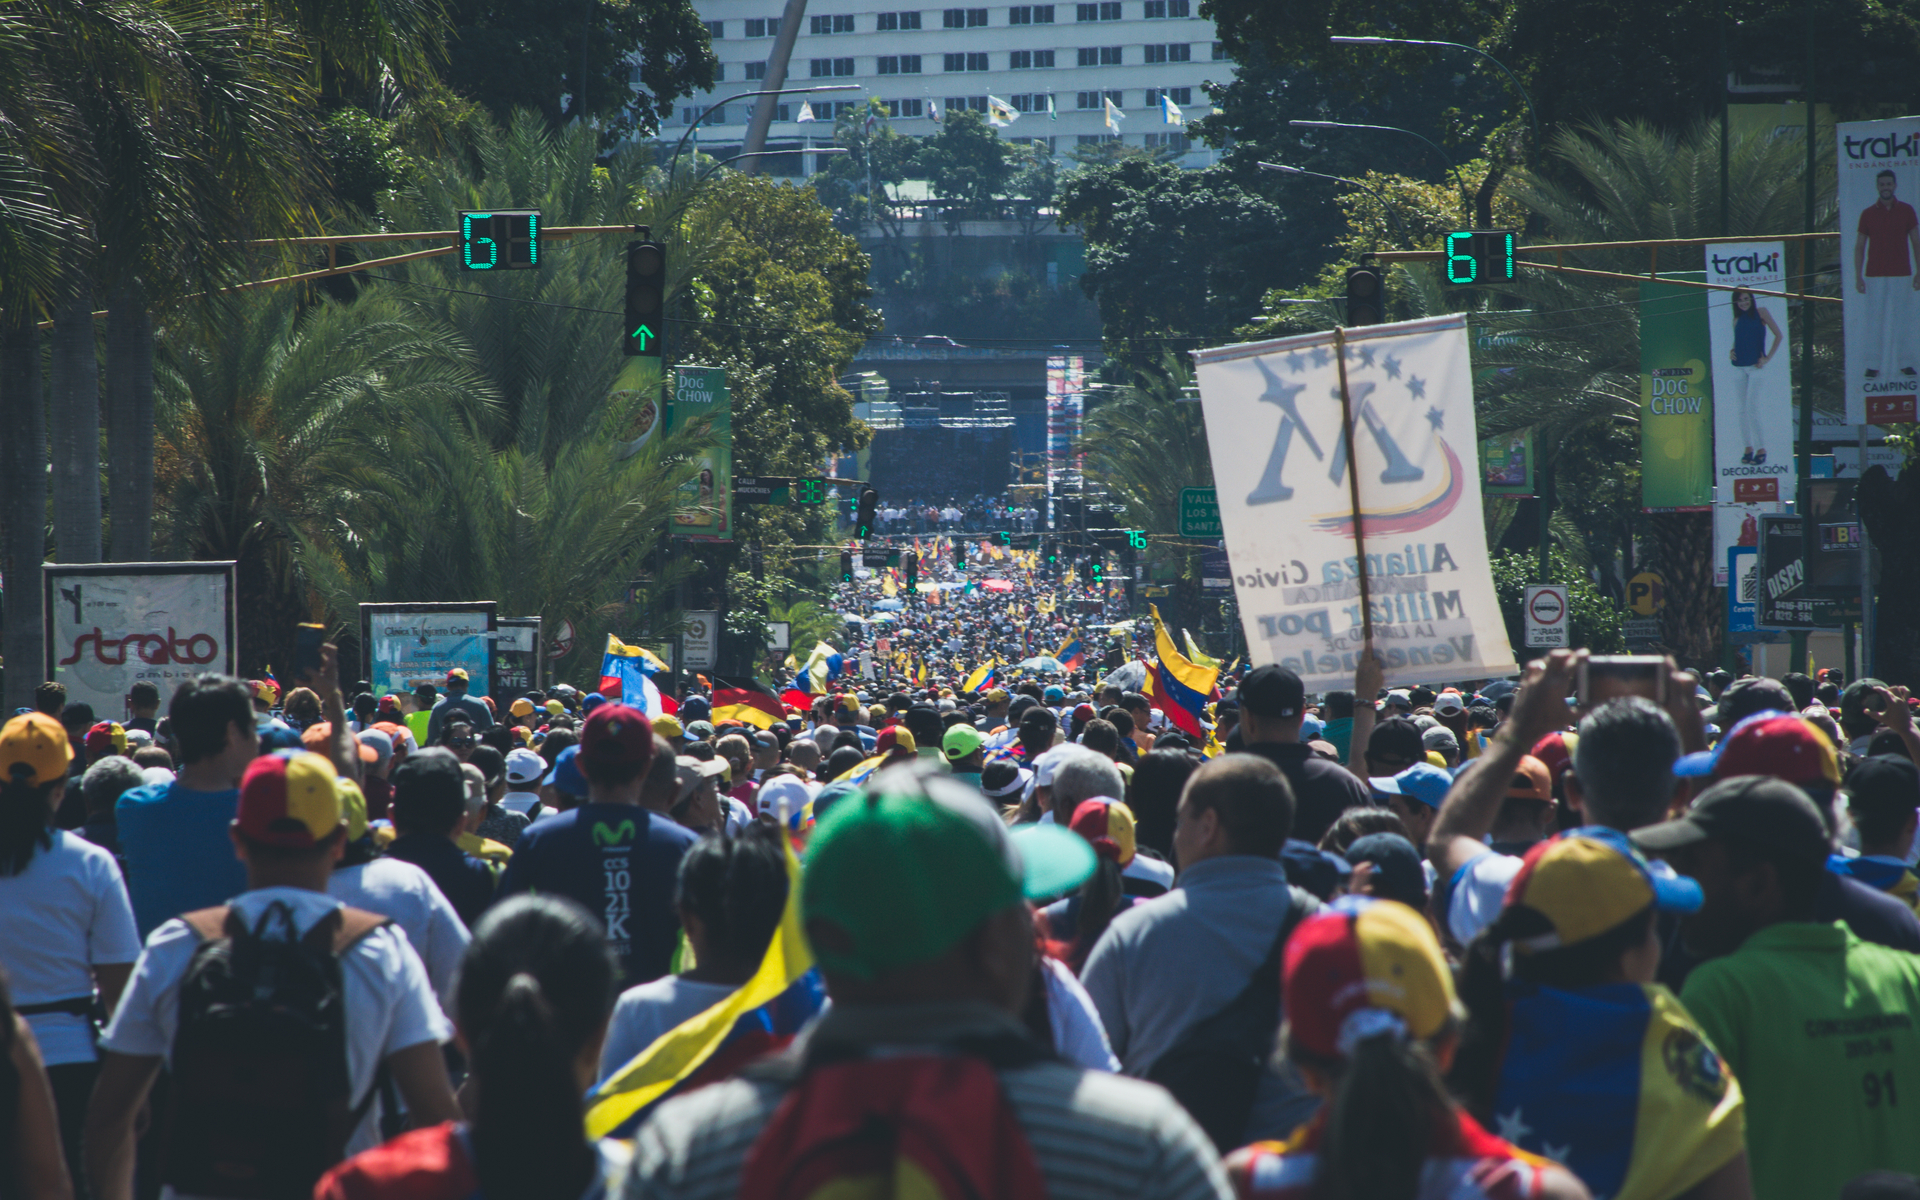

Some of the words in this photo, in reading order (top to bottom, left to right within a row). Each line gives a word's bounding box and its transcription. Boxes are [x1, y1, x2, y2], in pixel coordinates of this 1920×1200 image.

[1844, 132, 1920, 160] traki
[463, 214, 538, 269] 61
[1447, 231, 1513, 283] 61
[1711, 252, 1780, 275] traki
[1660, 368, 1692, 376] PURINA
[1863, 380, 1918, 392] CAMPING
[1722, 464, 1788, 476] DECORACIÓN
[1186, 508, 1207, 518] LOS
[1186, 522, 1222, 532] SANTA
[59, 626, 218, 664] strato
[604, 870, 631, 892] 10
[604, 892, 631, 914] 21
[605, 912, 632, 940] K
[1862, 1069, 1898, 1109] 91
